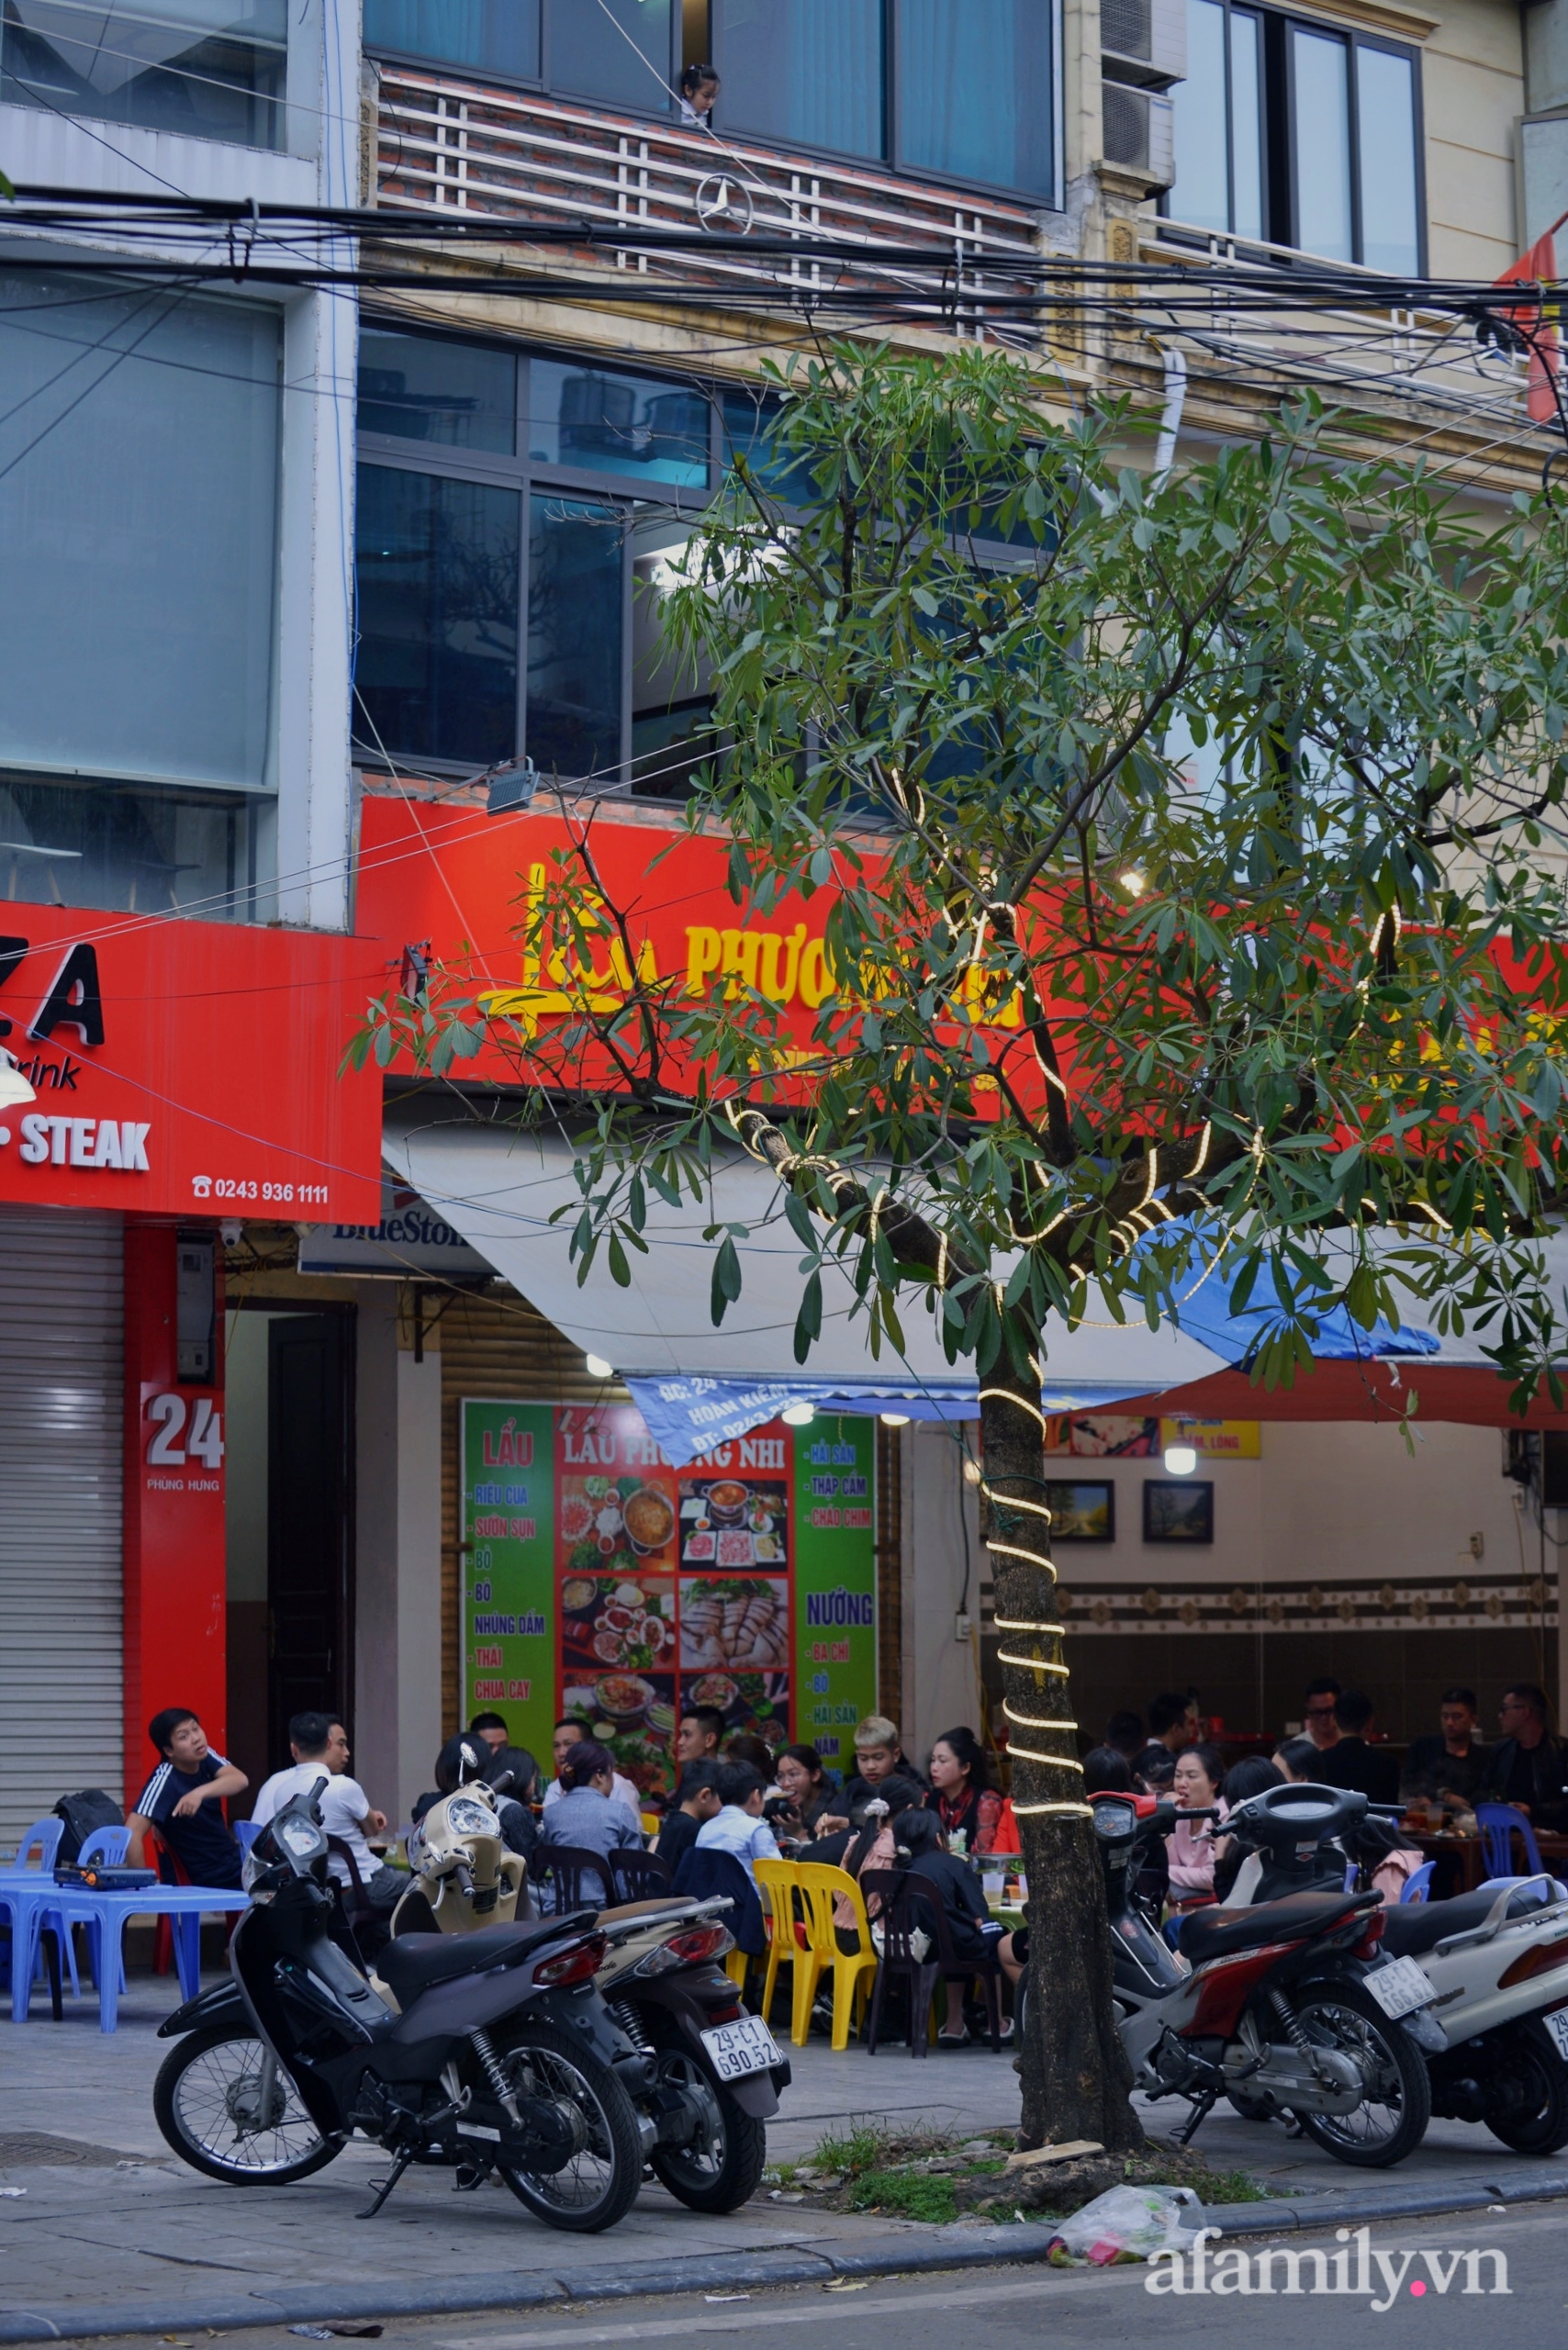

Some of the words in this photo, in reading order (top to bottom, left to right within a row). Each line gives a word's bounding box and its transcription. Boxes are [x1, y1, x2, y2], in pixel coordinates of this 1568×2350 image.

[8, 1055, 81, 1090] rink
[19, 1113, 151, 1171] STEAK
[215, 1179, 258, 1200] 0243
[262, 1182, 294, 1202] 936
[297, 1184, 328, 1204] 1111
[687, 1399, 741, 1427] HOÀN
[147, 1393, 225, 1469] 24
[484, 1416, 533, 1467] LẨU
[739, 1438, 785, 1469] NHI
[147, 1475, 184, 1491] PHÙNG
[474, 1480, 502, 1505] RIÊU
[505, 1484, 528, 1505] CUA
[811, 1472, 839, 1501] THẬP
[510, 1516, 535, 1543] SỤN
[844, 1507, 871, 1529] CHIM
[806, 1585, 874, 1627] NƯỚNG
[475, 1642, 502, 1668] THÁI
[812, 1640, 828, 1662] BA
[474, 1679, 506, 1700] CHUA
[509, 1679, 531, 1700] CAY
[711, 2021, 761, 2053] 29-C1
[717, 2042, 778, 2076] 690.52
